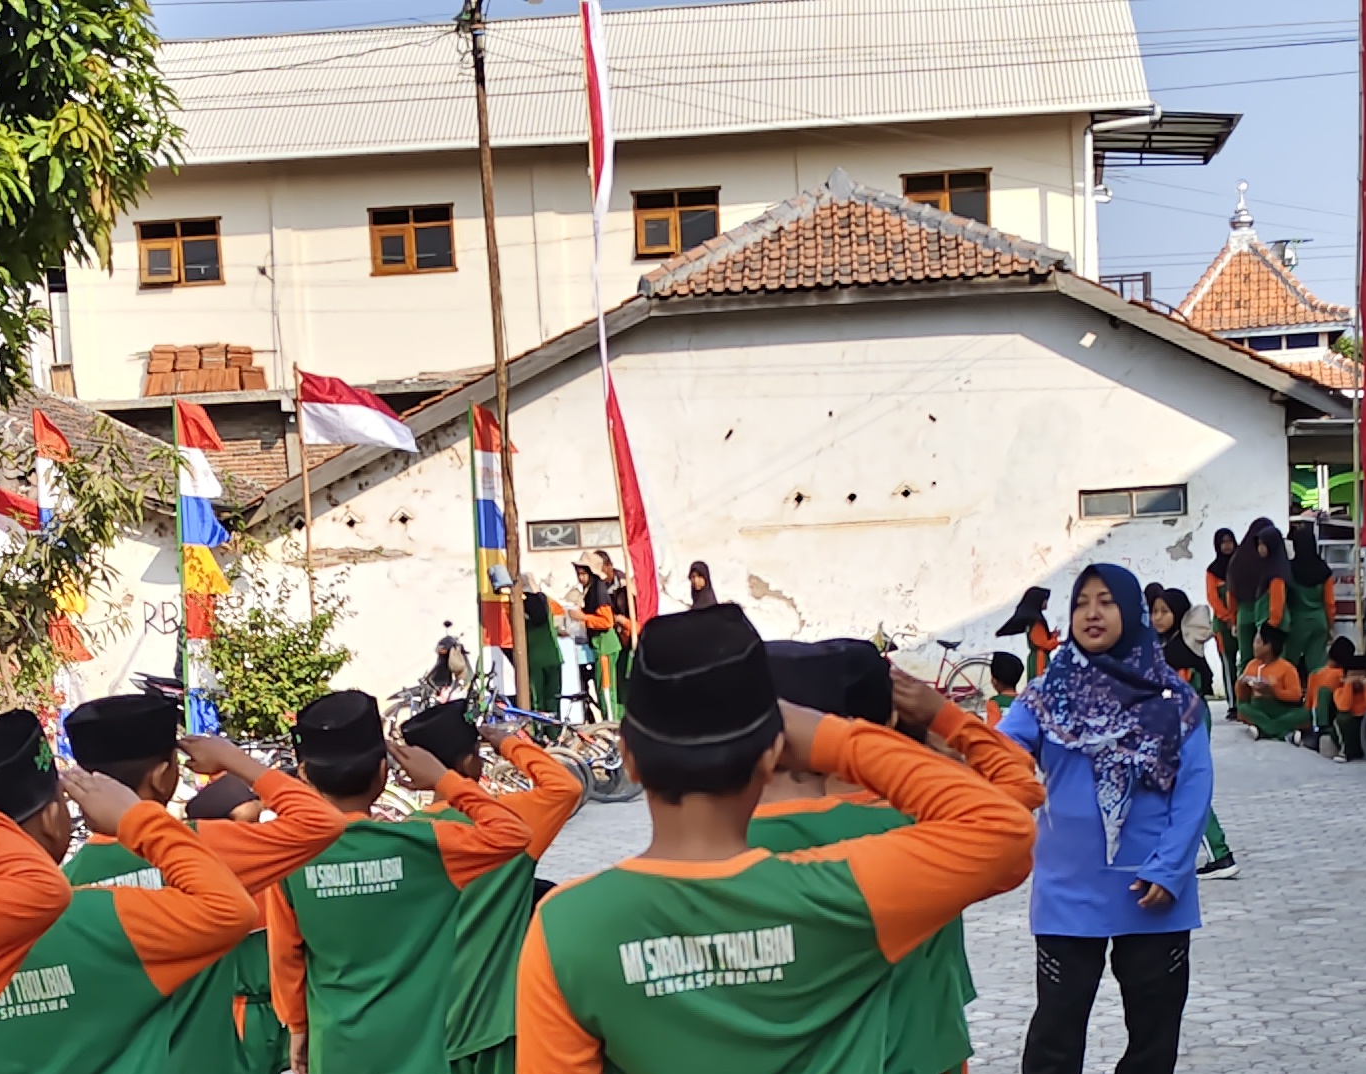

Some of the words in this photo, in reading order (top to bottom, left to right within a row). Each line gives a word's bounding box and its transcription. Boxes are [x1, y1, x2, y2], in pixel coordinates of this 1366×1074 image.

[643, 935, 713, 980] SIROJUT
[712, 924, 795, 970] THOLIBIN
[645, 967, 784, 997] RENGASPENDAWA
